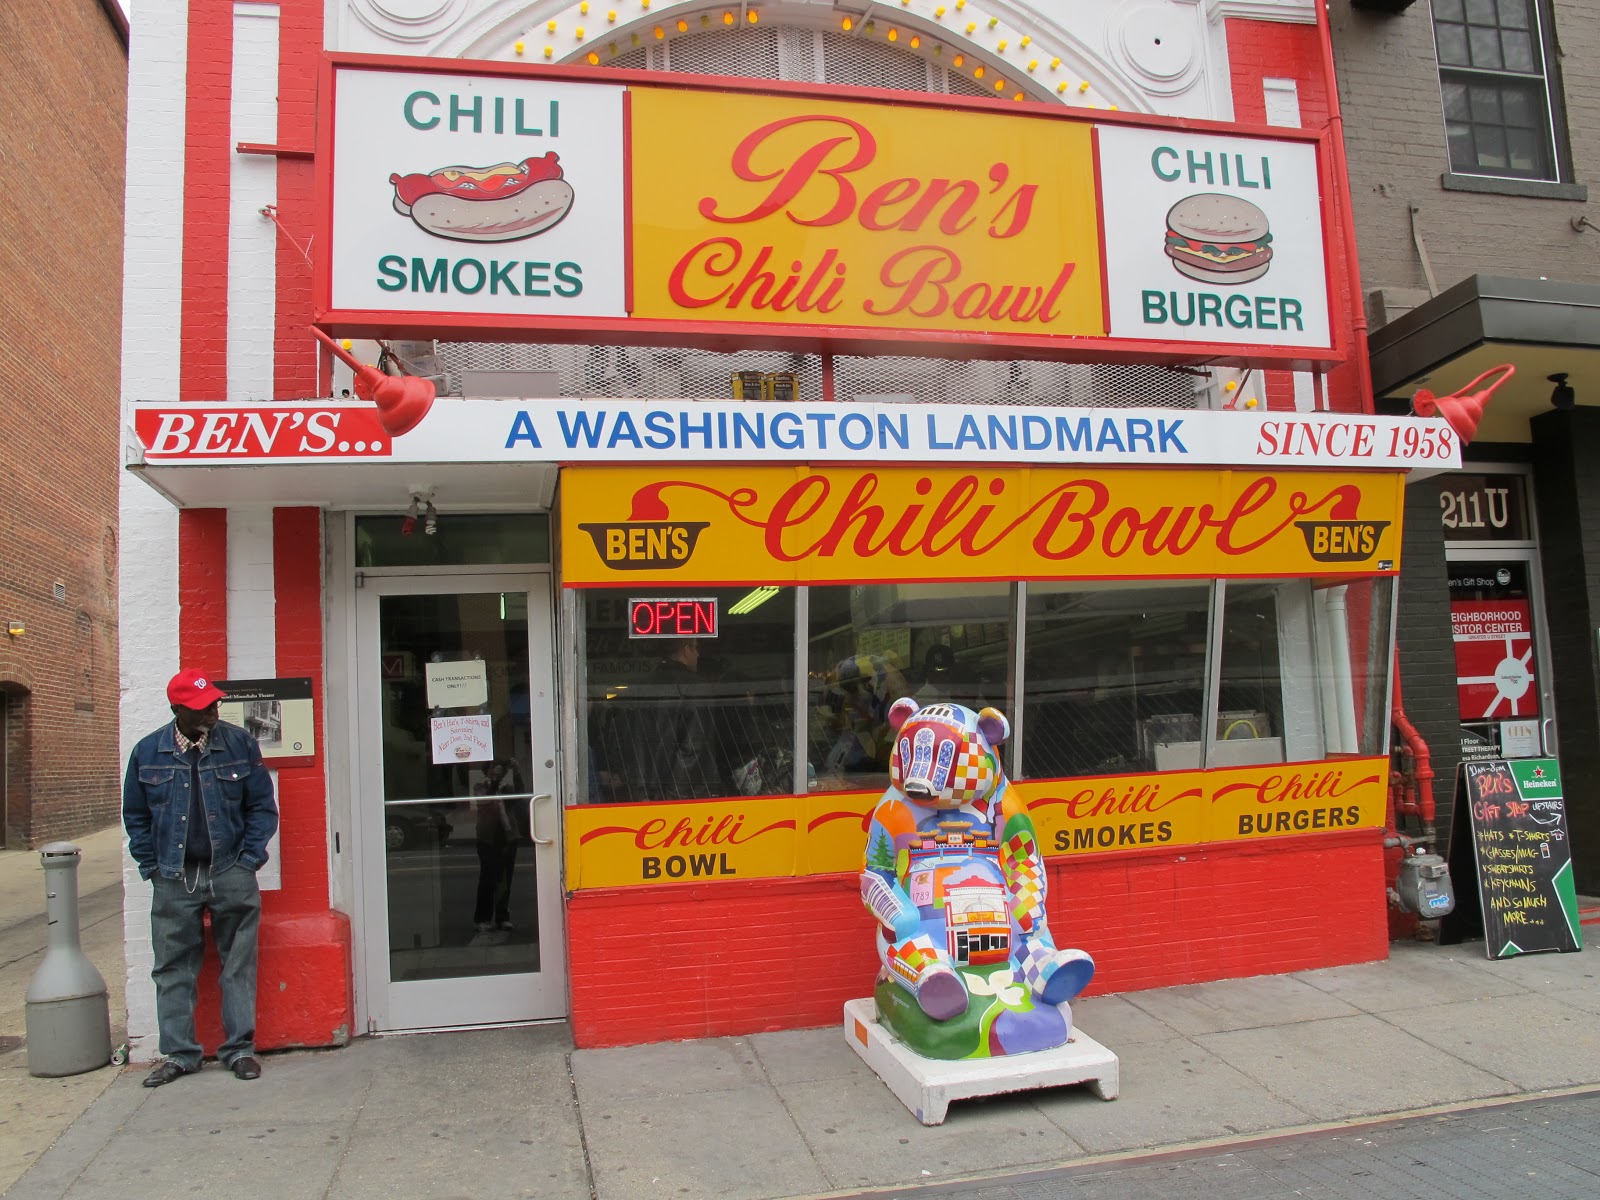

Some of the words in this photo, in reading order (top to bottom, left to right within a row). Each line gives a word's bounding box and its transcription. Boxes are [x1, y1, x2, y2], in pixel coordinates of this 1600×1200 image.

[404, 90, 559, 137] CHILI
[698, 114, 1038, 239] Ben's
[1152, 146, 1272, 189] CHILI
[376, 254, 583, 297] SMOKES
[668, 236, 846, 313] Chili
[864, 245, 1076, 323] Bowl
[1142, 289, 1304, 331] BURGER
[146, 411, 383, 455] BEN'S...
[504, 410, 542, 449] A
[556, 410, 910, 451] WASHINGTON
[927, 413, 1188, 454] LANDMARK
[1256, 421, 1376, 457] SINCE
[1387, 425, 1453, 460] 1958
[606, 526, 689, 561] BEN'S
[764, 473, 1025, 562] Chili
[1031, 476, 1285, 561] Bowl
[1313, 524, 1375, 554] BEN'S
[1463, 578, 1475, 586] Gift
[1476, 578, 1494, 587] Shop
[632, 602, 714, 635] OPEN
[1451, 611, 1521, 622] EIGHBORHOOD
[1485, 622, 1522, 633] CENTER
[1508, 726, 1532, 737] OPEN
[1256, 770, 1348, 804] Chili
[1523, 780, 1557, 789] Heineken
[1065, 784, 1164, 820] Chili
[1505, 801, 1530, 818] SHOP
[1532, 801, 1562, 811] UPSTAIRS
[633, 813, 755, 850] Chili
[1054, 820, 1172, 852] SMOKES
[1238, 805, 1360, 835] BURGERS
[642, 852, 736, 880] BOWL
[912, 891, 930, 903] 1789
[1490, 896, 1511, 911] AND
